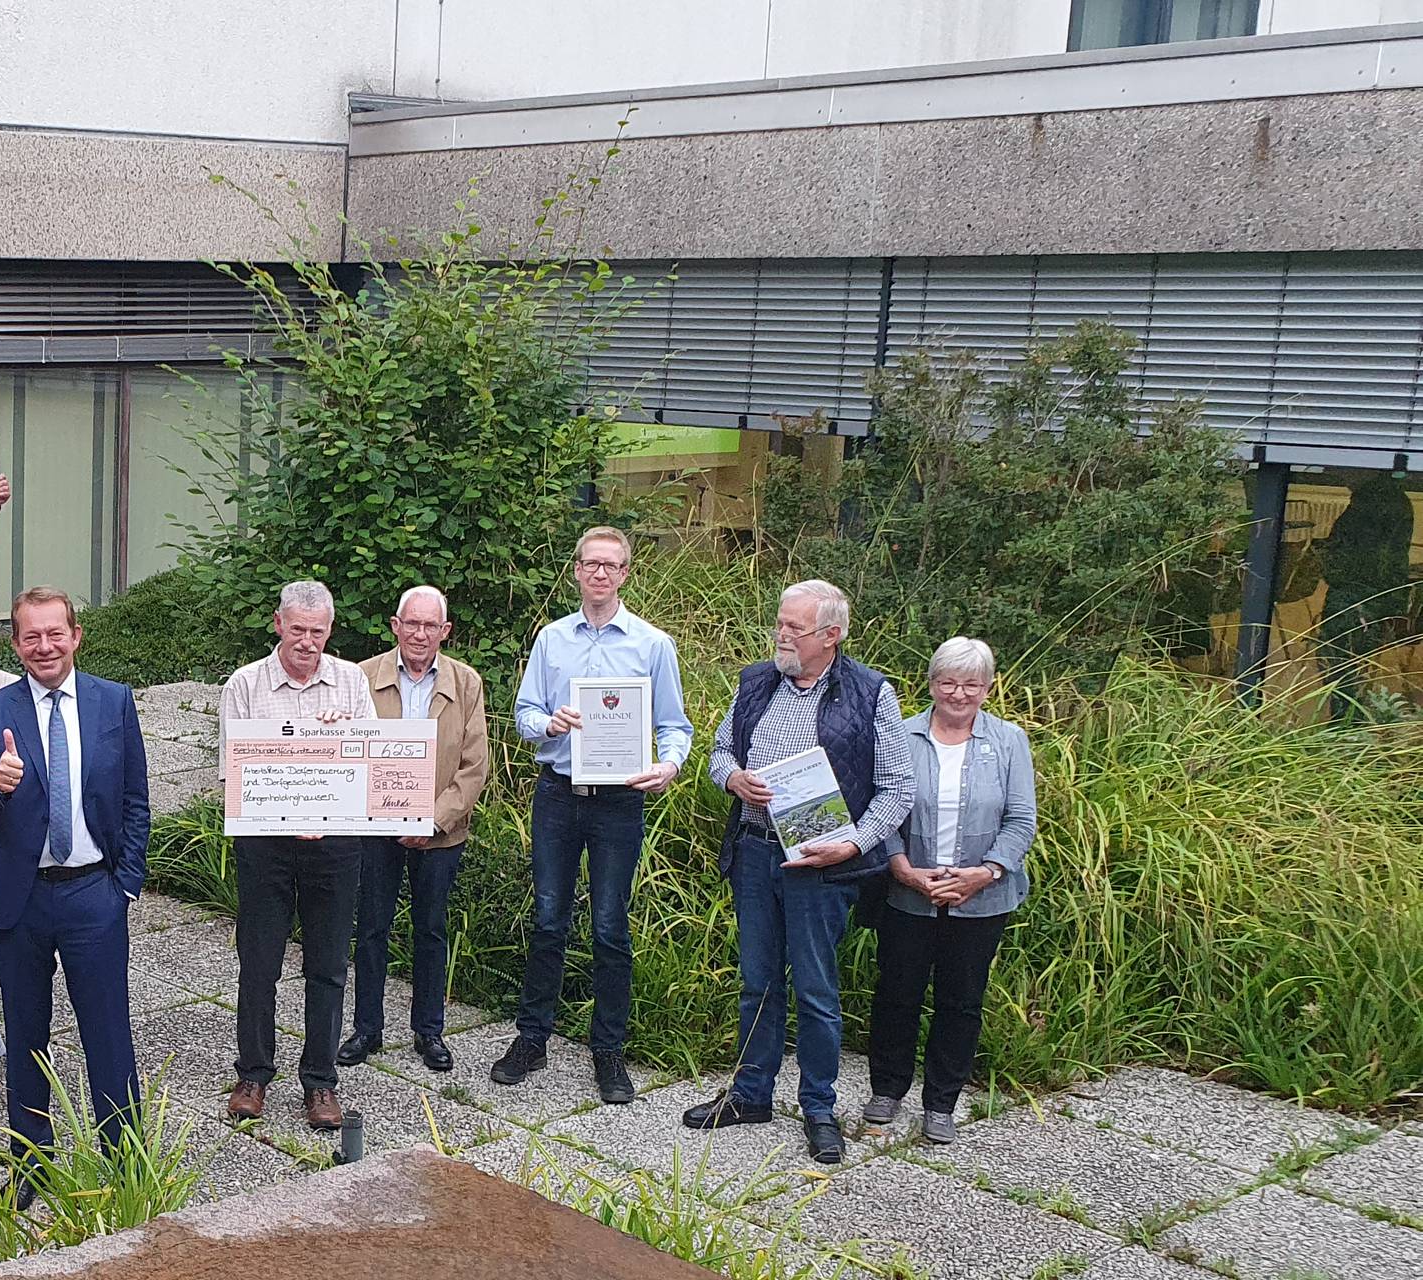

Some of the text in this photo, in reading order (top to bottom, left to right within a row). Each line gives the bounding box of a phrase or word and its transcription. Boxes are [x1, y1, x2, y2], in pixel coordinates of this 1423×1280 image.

[589, 712, 633, 720] URKUNDE
[299, 728, 345, 738] Sparkasse
[349, 728, 381, 738] Siegen
